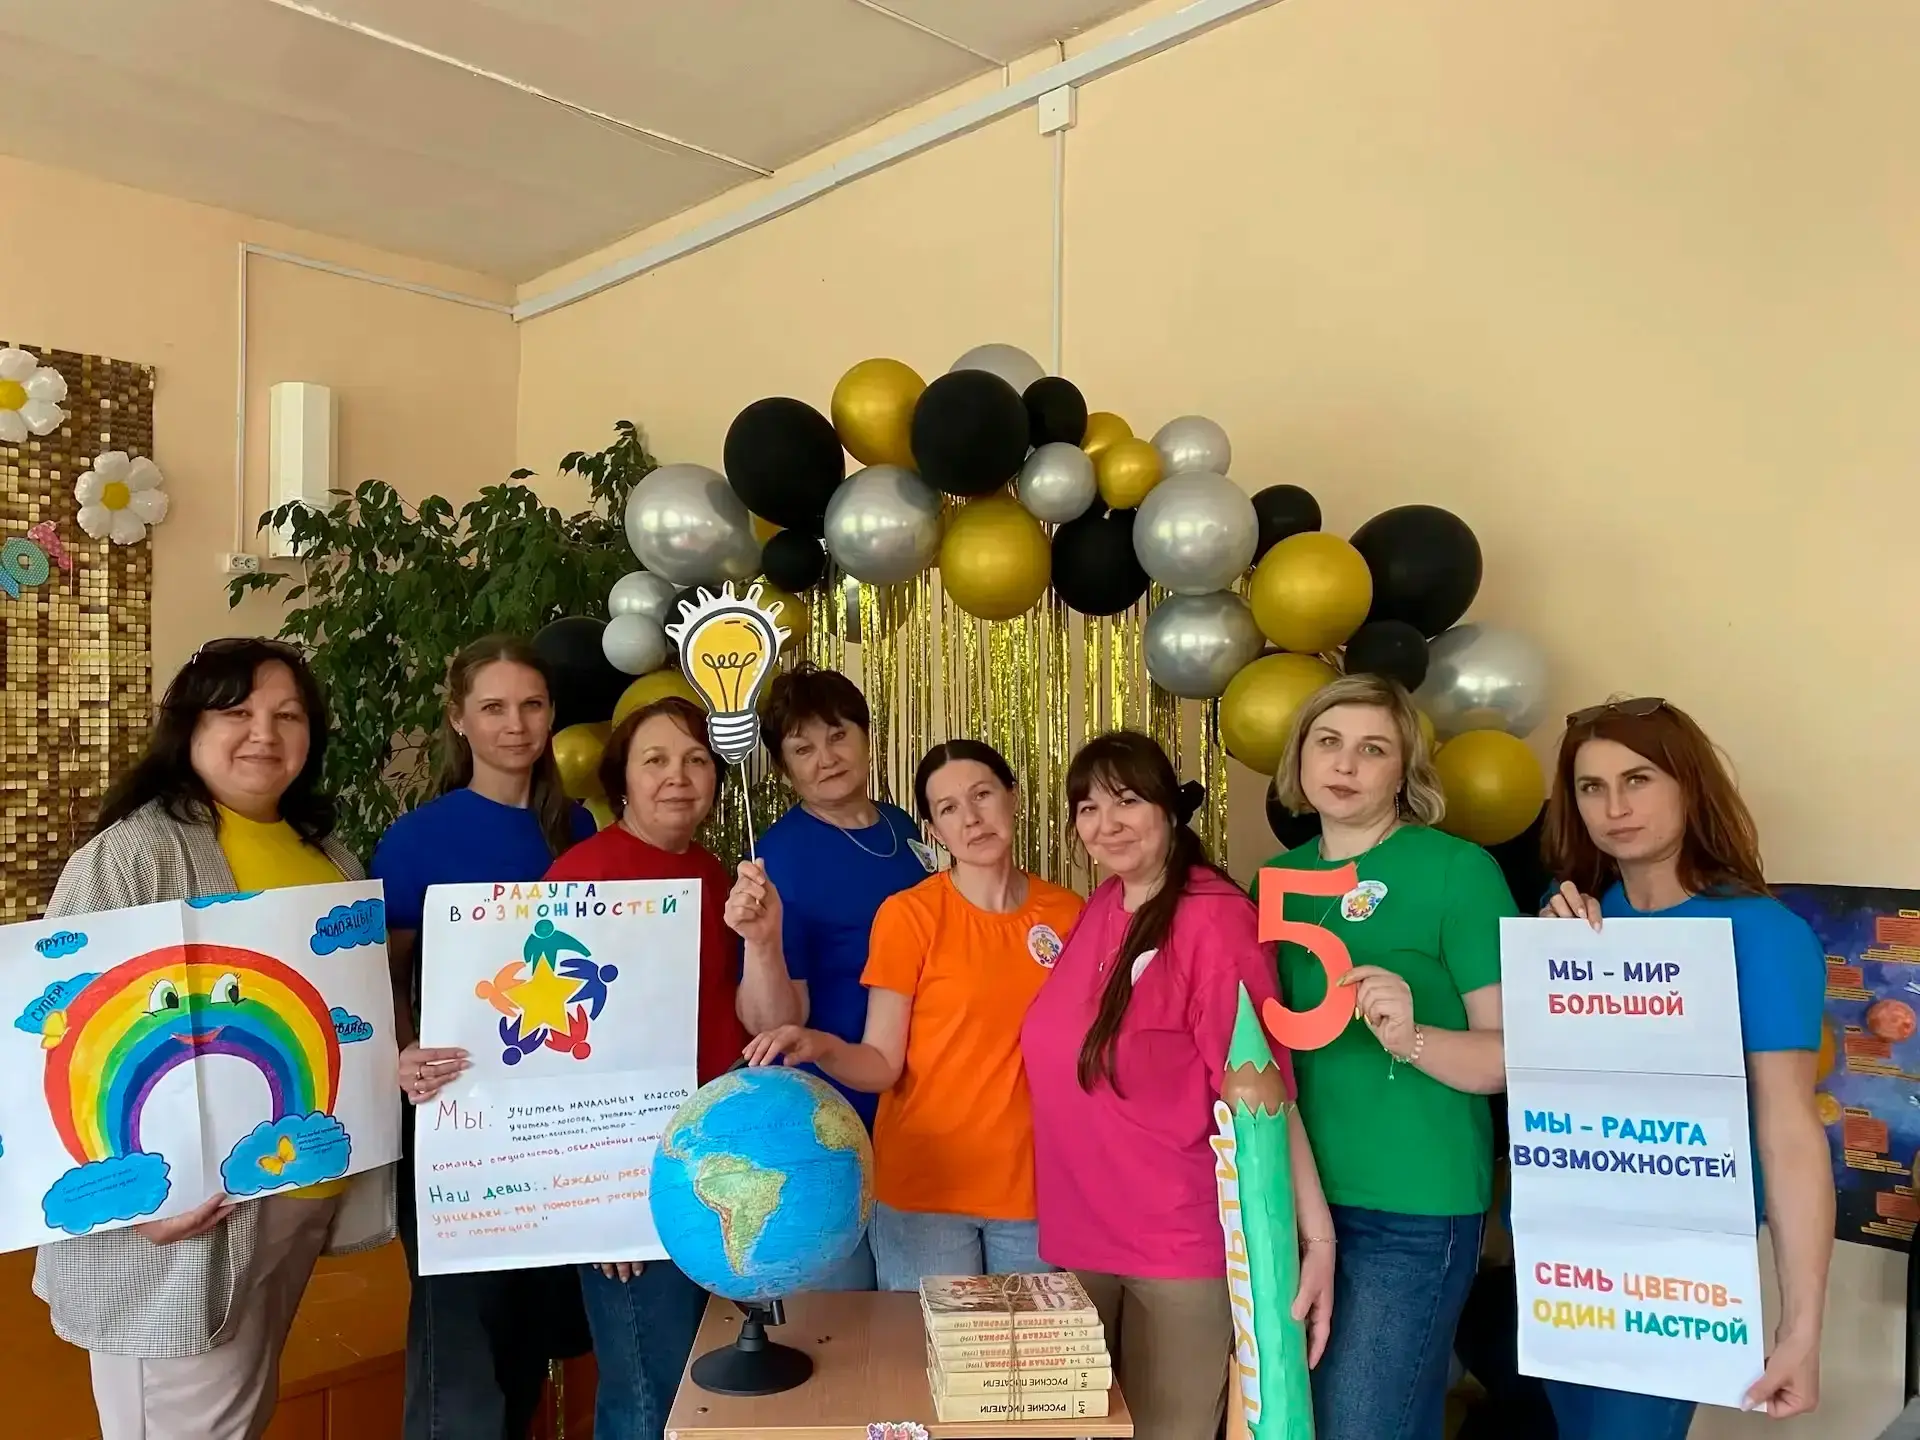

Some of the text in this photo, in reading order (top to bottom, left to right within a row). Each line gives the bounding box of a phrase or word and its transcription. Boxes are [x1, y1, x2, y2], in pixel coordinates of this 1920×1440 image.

[36, 932, 79, 952] КРУТО!
[1257, 861, 1359, 1051] 5
[1547, 959, 1594, 982] МЫ
[1623, 961, 1681, 984] МИР
[30, 984, 70, 1022] СУПЕР!
[1547, 990, 1684, 1018] БОЛЬШОЙ
[1525, 1110, 1572, 1135] МЫ
[1602, 1117, 1707, 1147] РАДУГА
[1513, 1144, 1736, 1179] ВОЗМОЖНОСТЕЙ
[1535, 1261, 1614, 1292] СЕМЬ
[1533, 1298, 1749, 1345] ОДИН НАСТРОЙ
[1029, 1377, 1068, 1387] РУССКИЕ
[1027, 1403, 1067, 1413] РУССКИЕ
